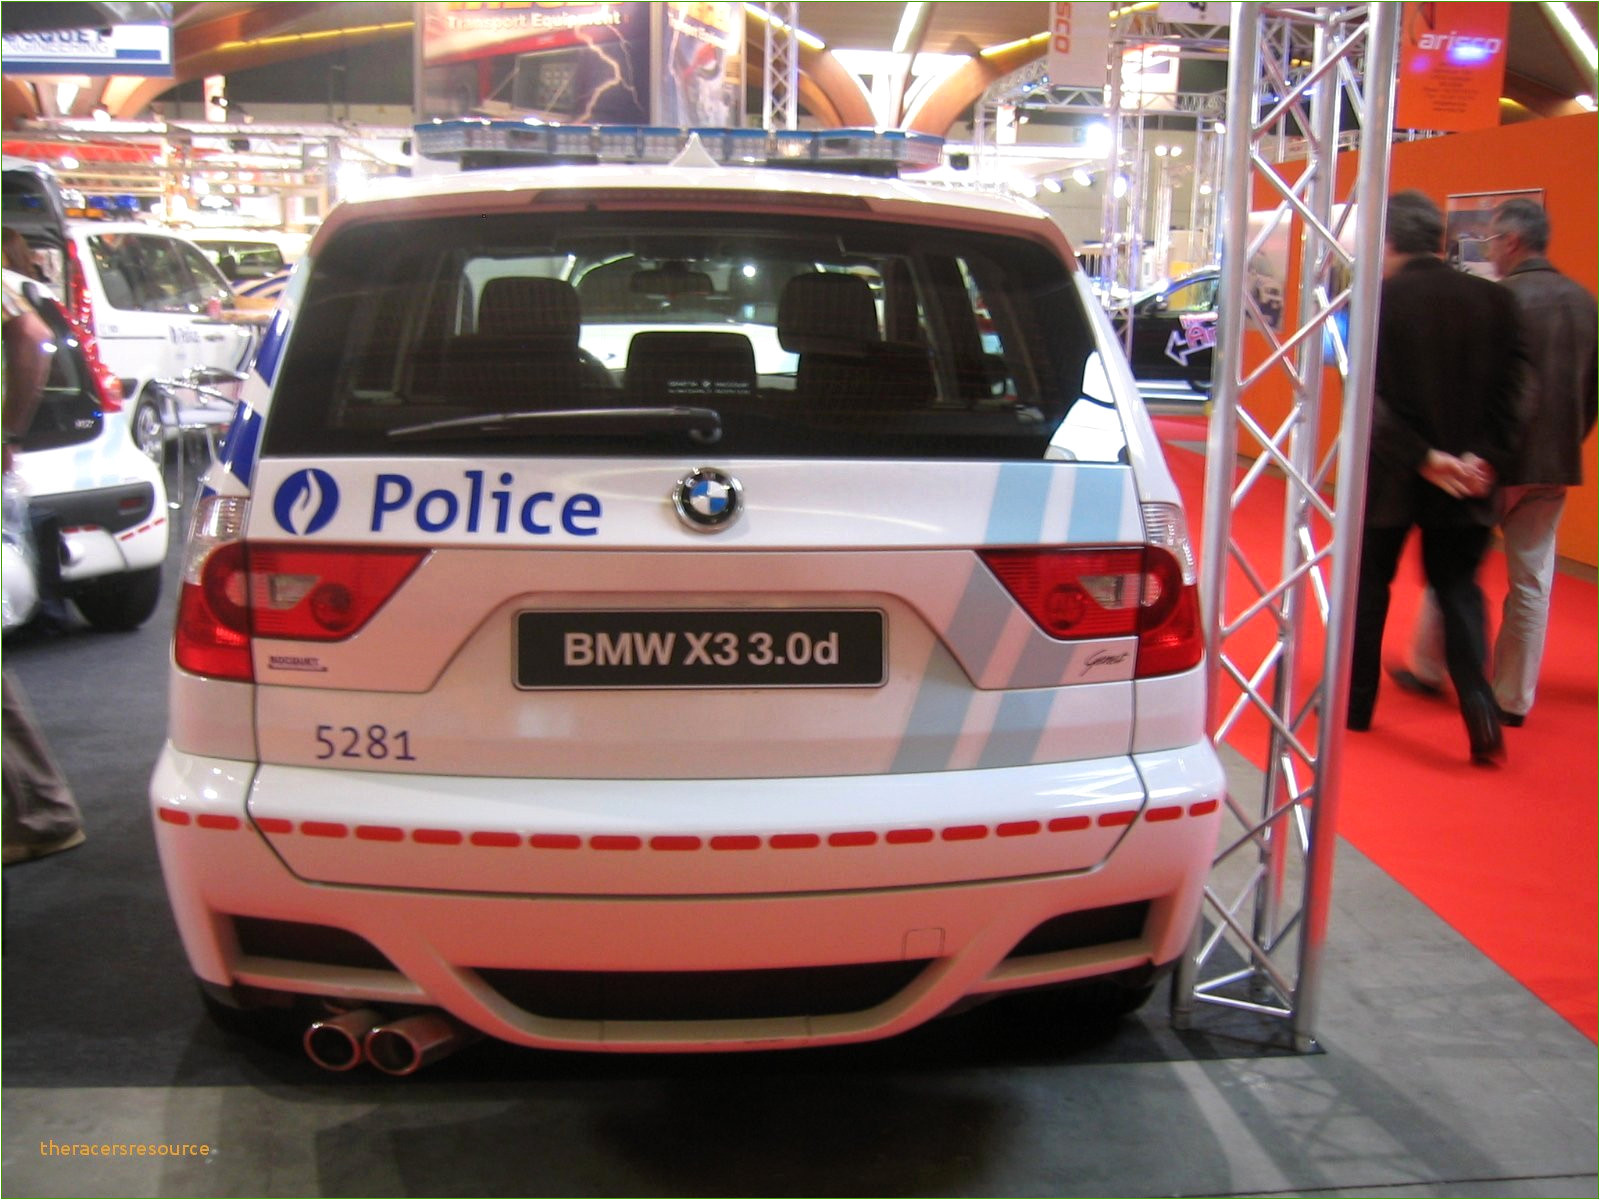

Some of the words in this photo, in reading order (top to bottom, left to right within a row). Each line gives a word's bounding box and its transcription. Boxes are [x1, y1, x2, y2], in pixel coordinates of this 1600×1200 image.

[370, 469, 602, 537] Police
[563, 632, 676, 667] BMW
[682, 632, 740, 666] X3
[747, 632, 840, 666] 3.0d
[315, 724, 417, 761] 5281
